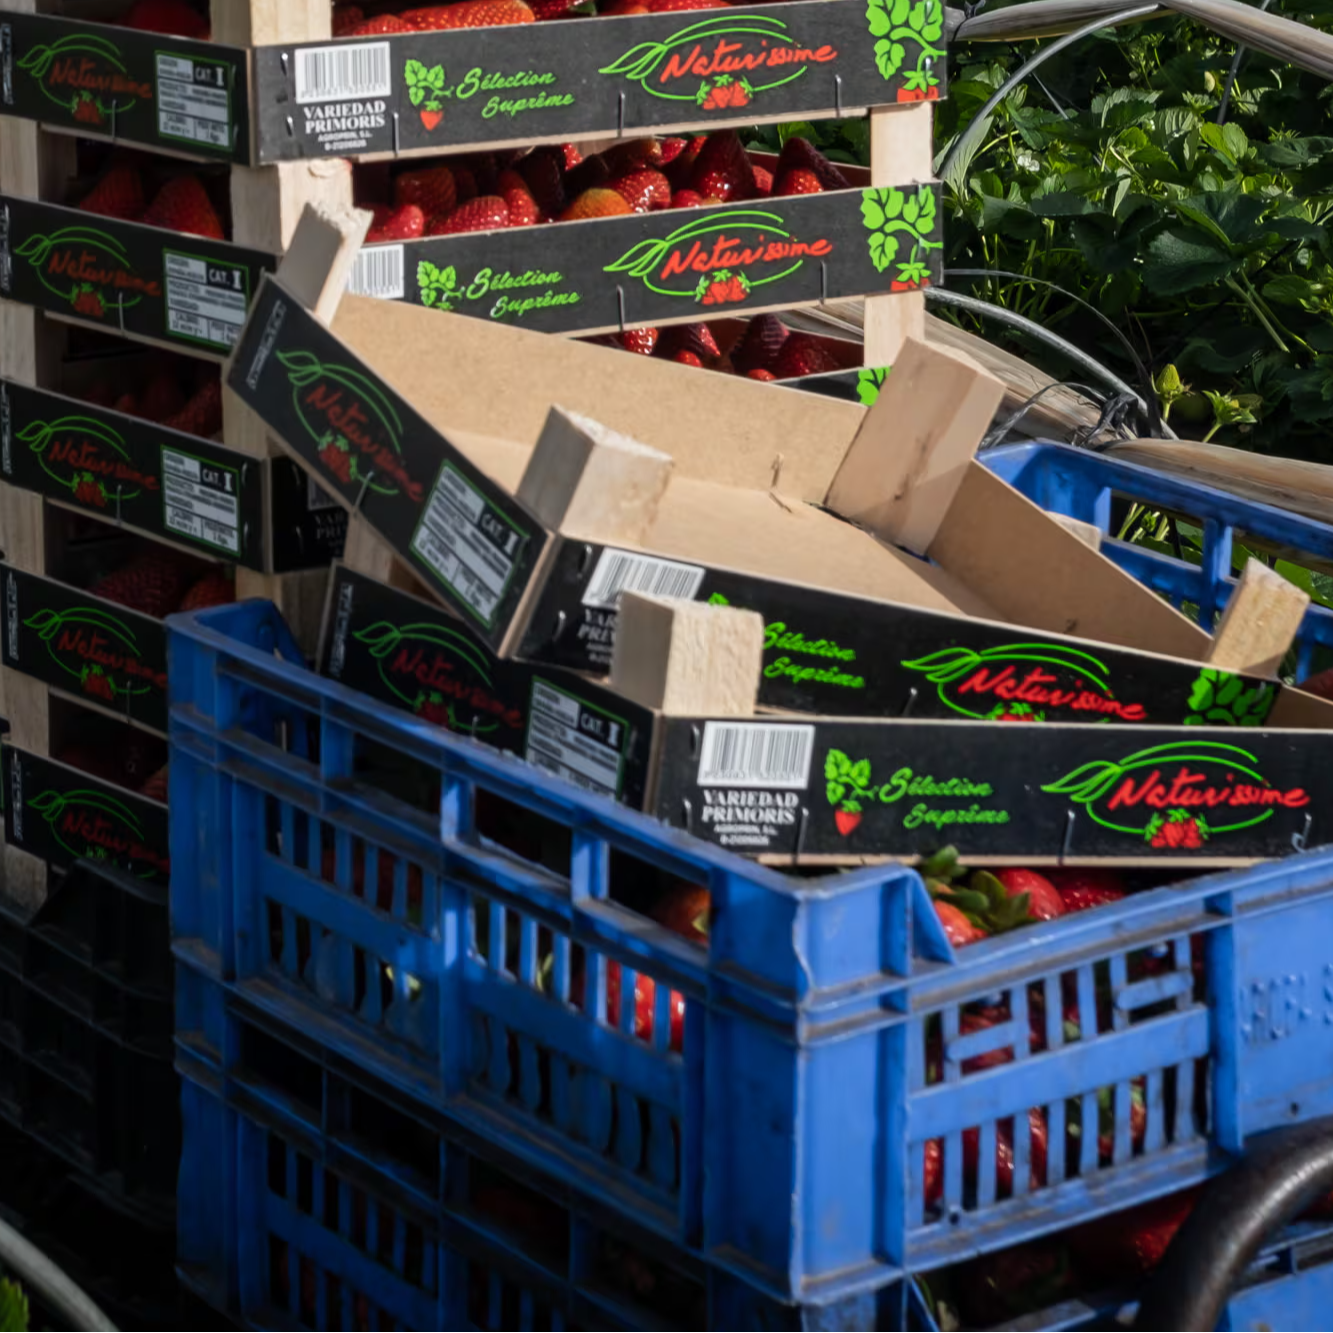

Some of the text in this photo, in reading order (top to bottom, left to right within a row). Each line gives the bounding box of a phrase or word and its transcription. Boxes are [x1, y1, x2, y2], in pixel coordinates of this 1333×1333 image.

[660, 39, 837, 83] Naturissime
[303, 100, 386, 119] VARIEDAD
[305, 116, 385, 134] PRIMORIS
[660, 235, 832, 280] Naturissime
[958, 668, 1147, 720] Naturissime
[704, 789, 799, 808] VARIEDAD
[1107, 767, 1310, 810] Naturissime
[701, 805, 796, 825] PRIMORIS
